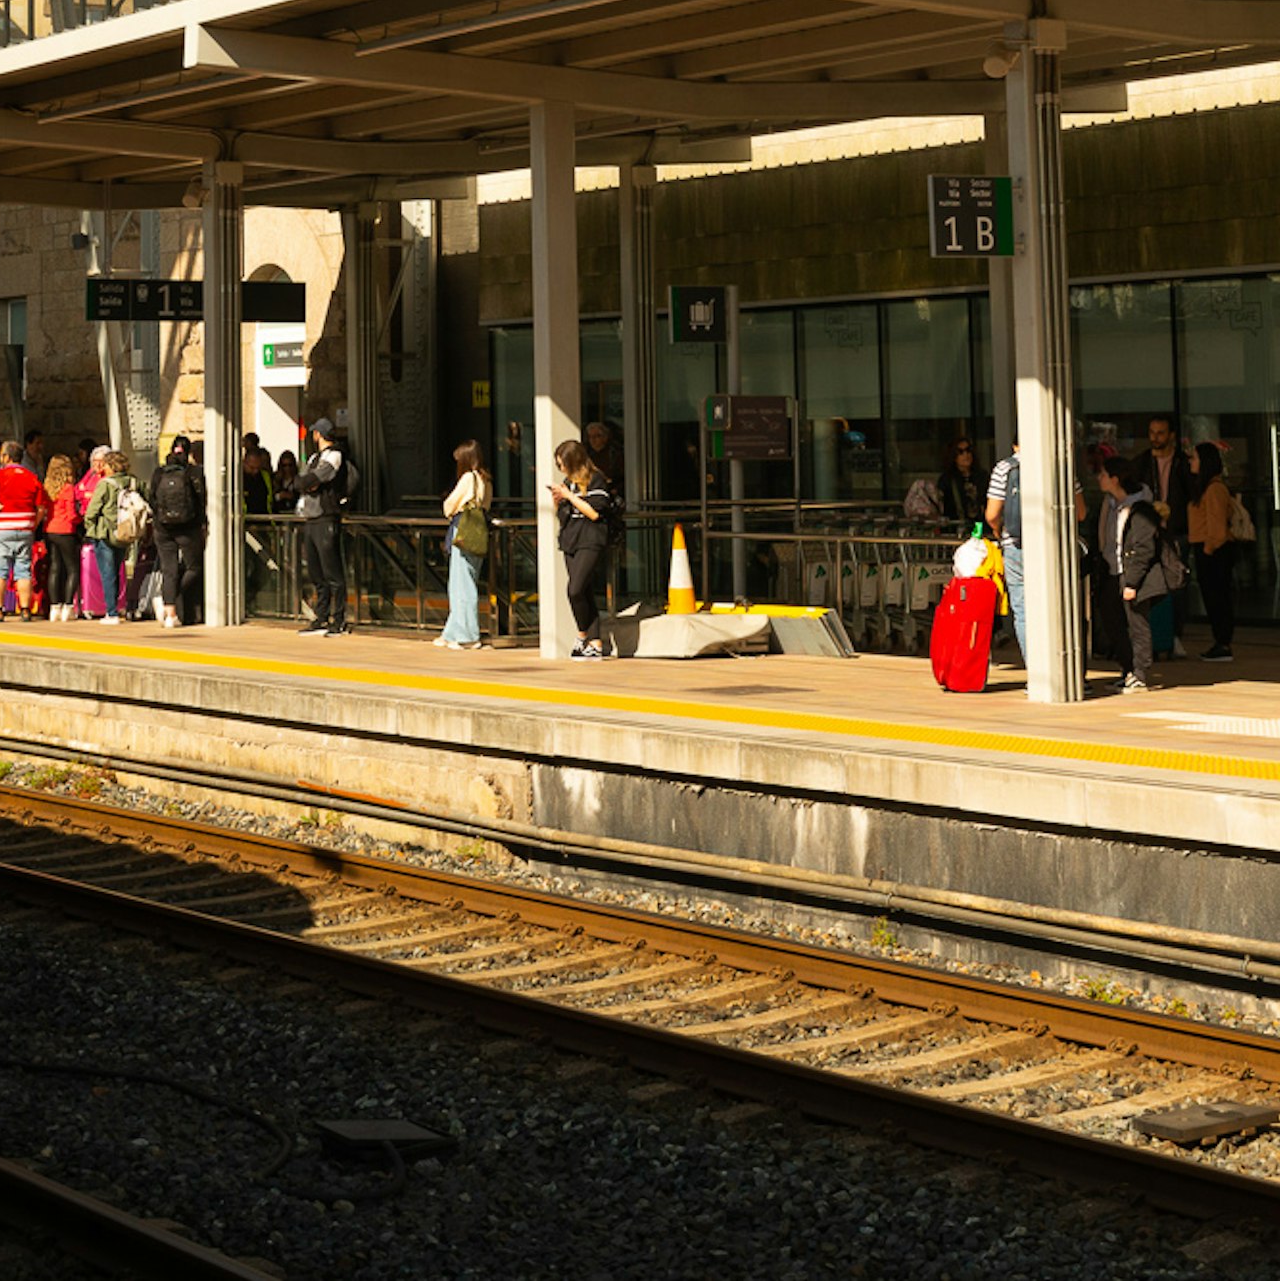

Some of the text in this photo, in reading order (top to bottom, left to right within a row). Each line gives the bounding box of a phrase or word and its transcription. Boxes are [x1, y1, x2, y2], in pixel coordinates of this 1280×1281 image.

[944, 216, 994, 251] 1 B
[157, 284, 175, 317] 1
